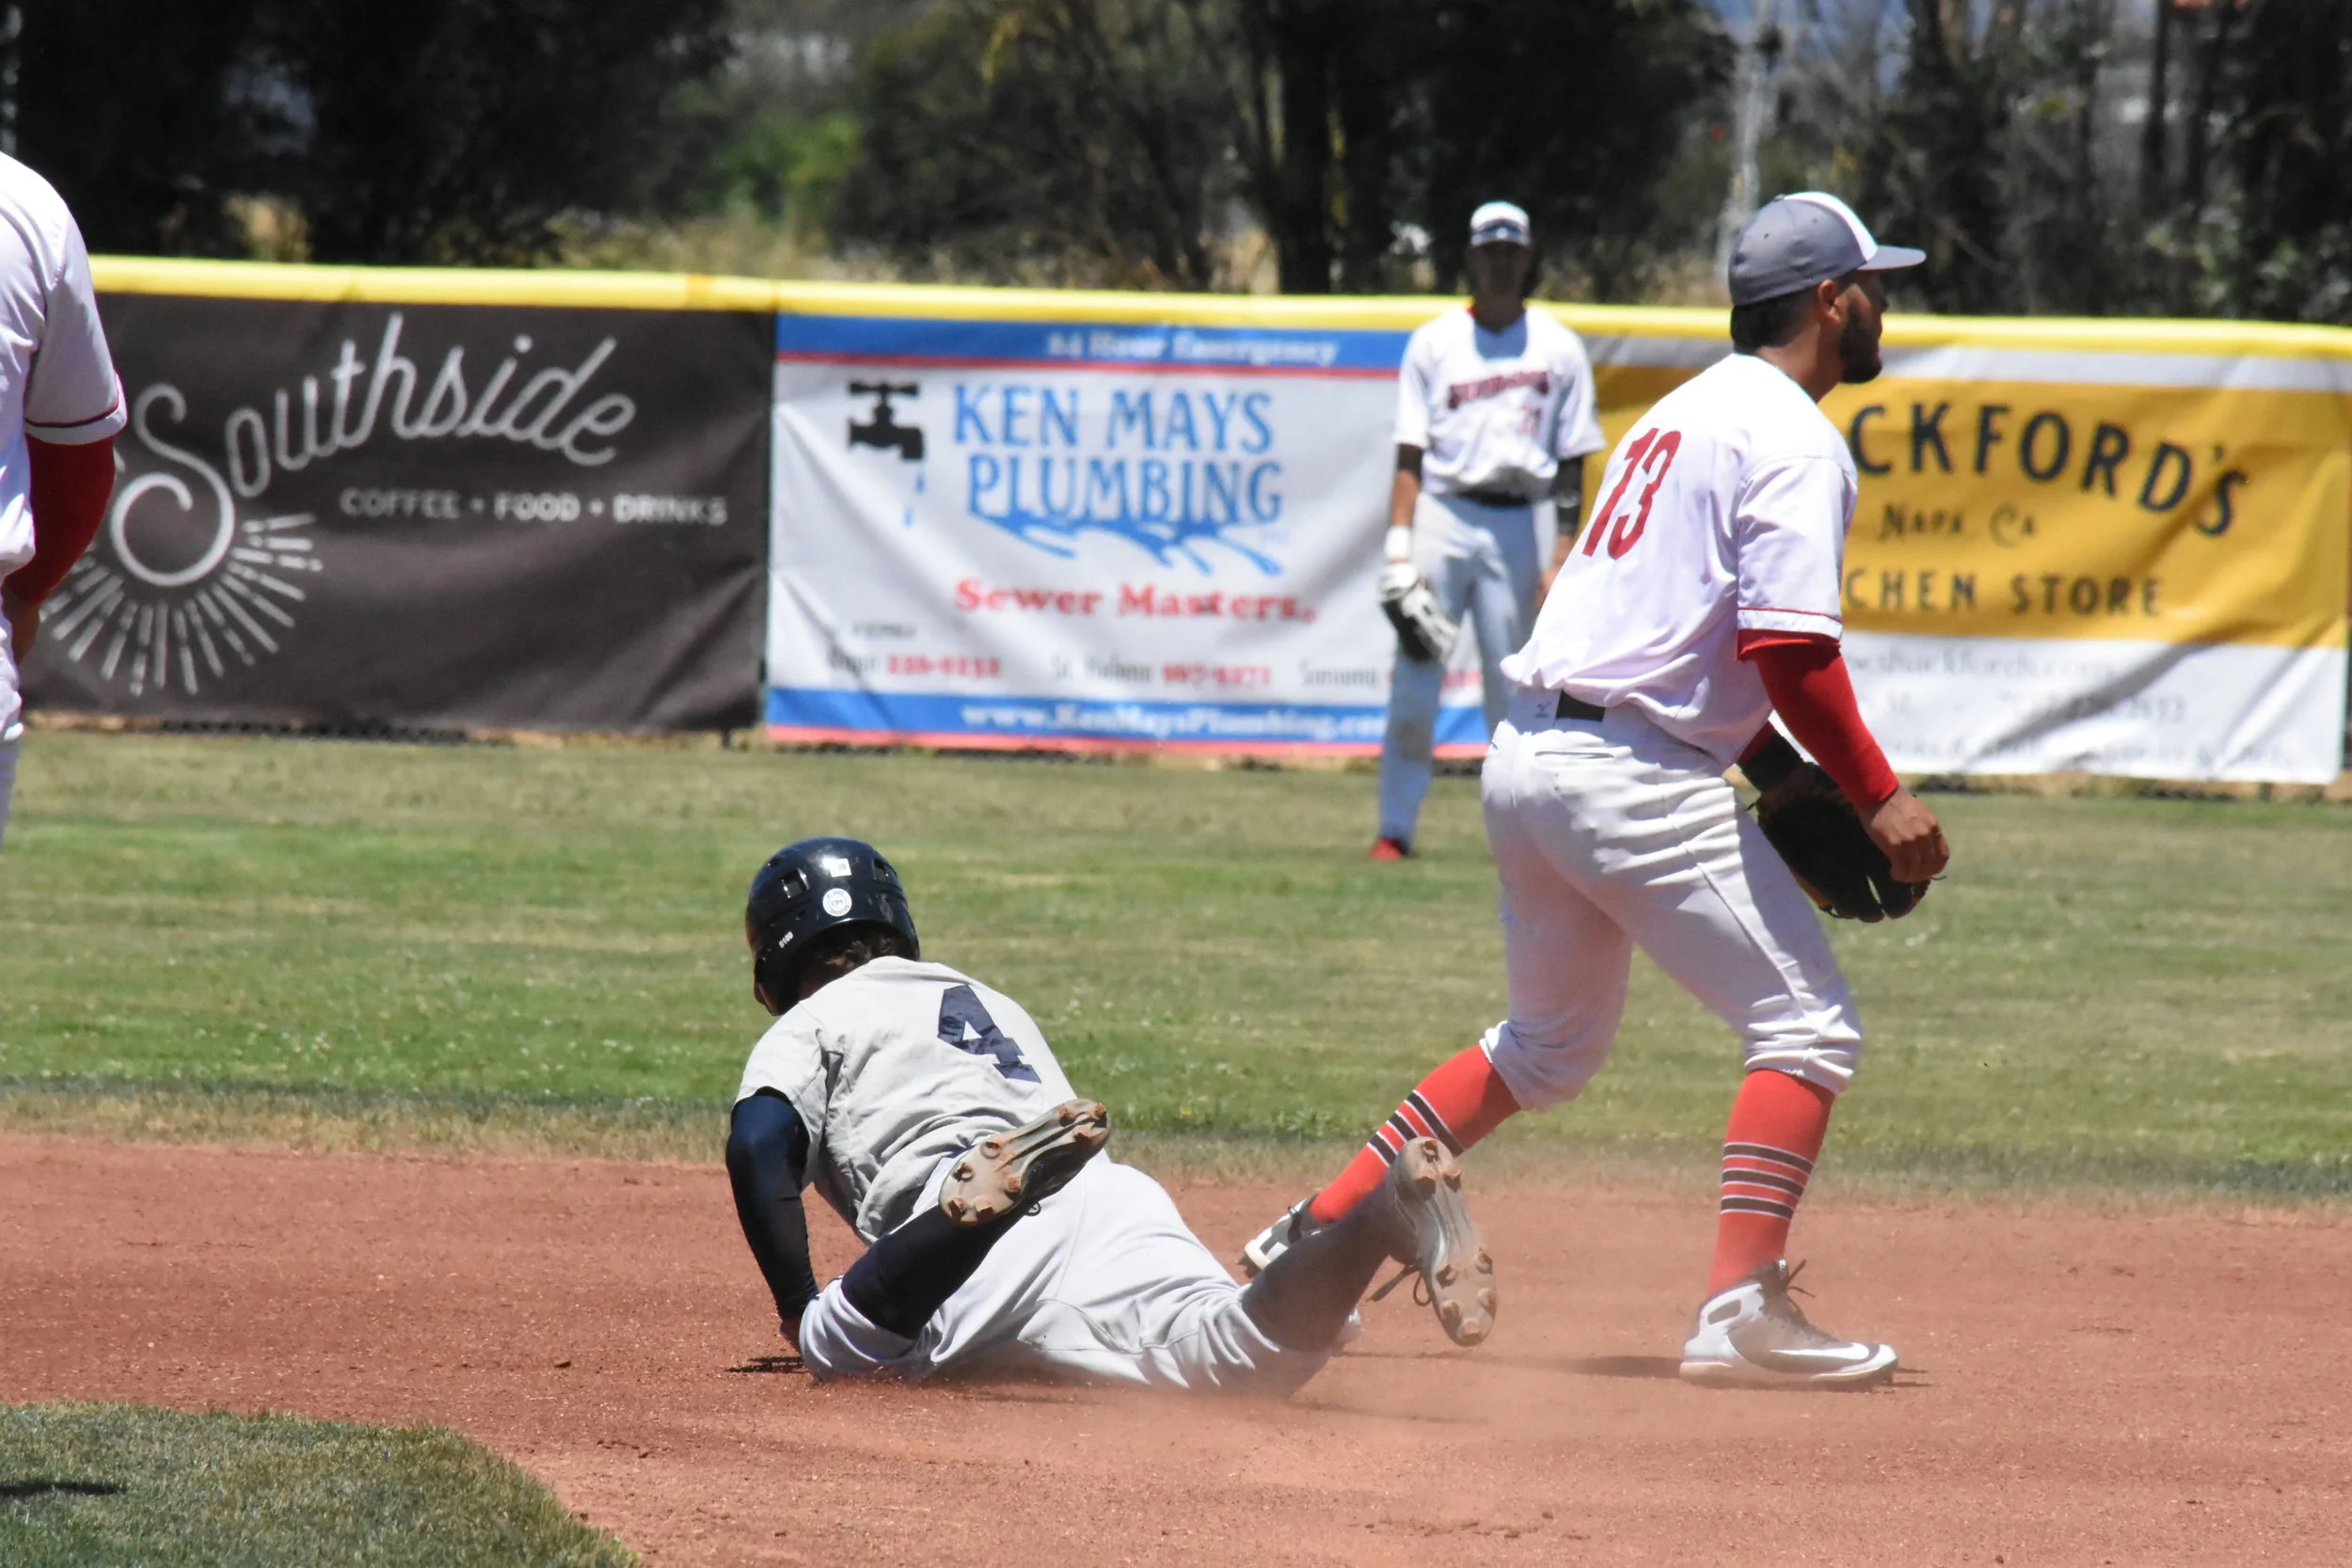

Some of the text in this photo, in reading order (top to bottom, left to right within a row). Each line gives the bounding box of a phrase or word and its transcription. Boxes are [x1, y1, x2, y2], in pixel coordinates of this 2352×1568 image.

[1172, 329, 1340, 366] Emergency
[111, 312, 637, 587] Southside
[954, 386, 1275, 455] KEN MAYS
[339, 487, 728, 526] COFFEE FOOD DRINKS
[967, 453, 1285, 525] PLUMBING
[1582, 427, 1682, 561] 13
[953, 577, 1104, 614] Sewer
[2010, 573, 2162, 617] STORE
[938, 984, 1042, 1084] 4
